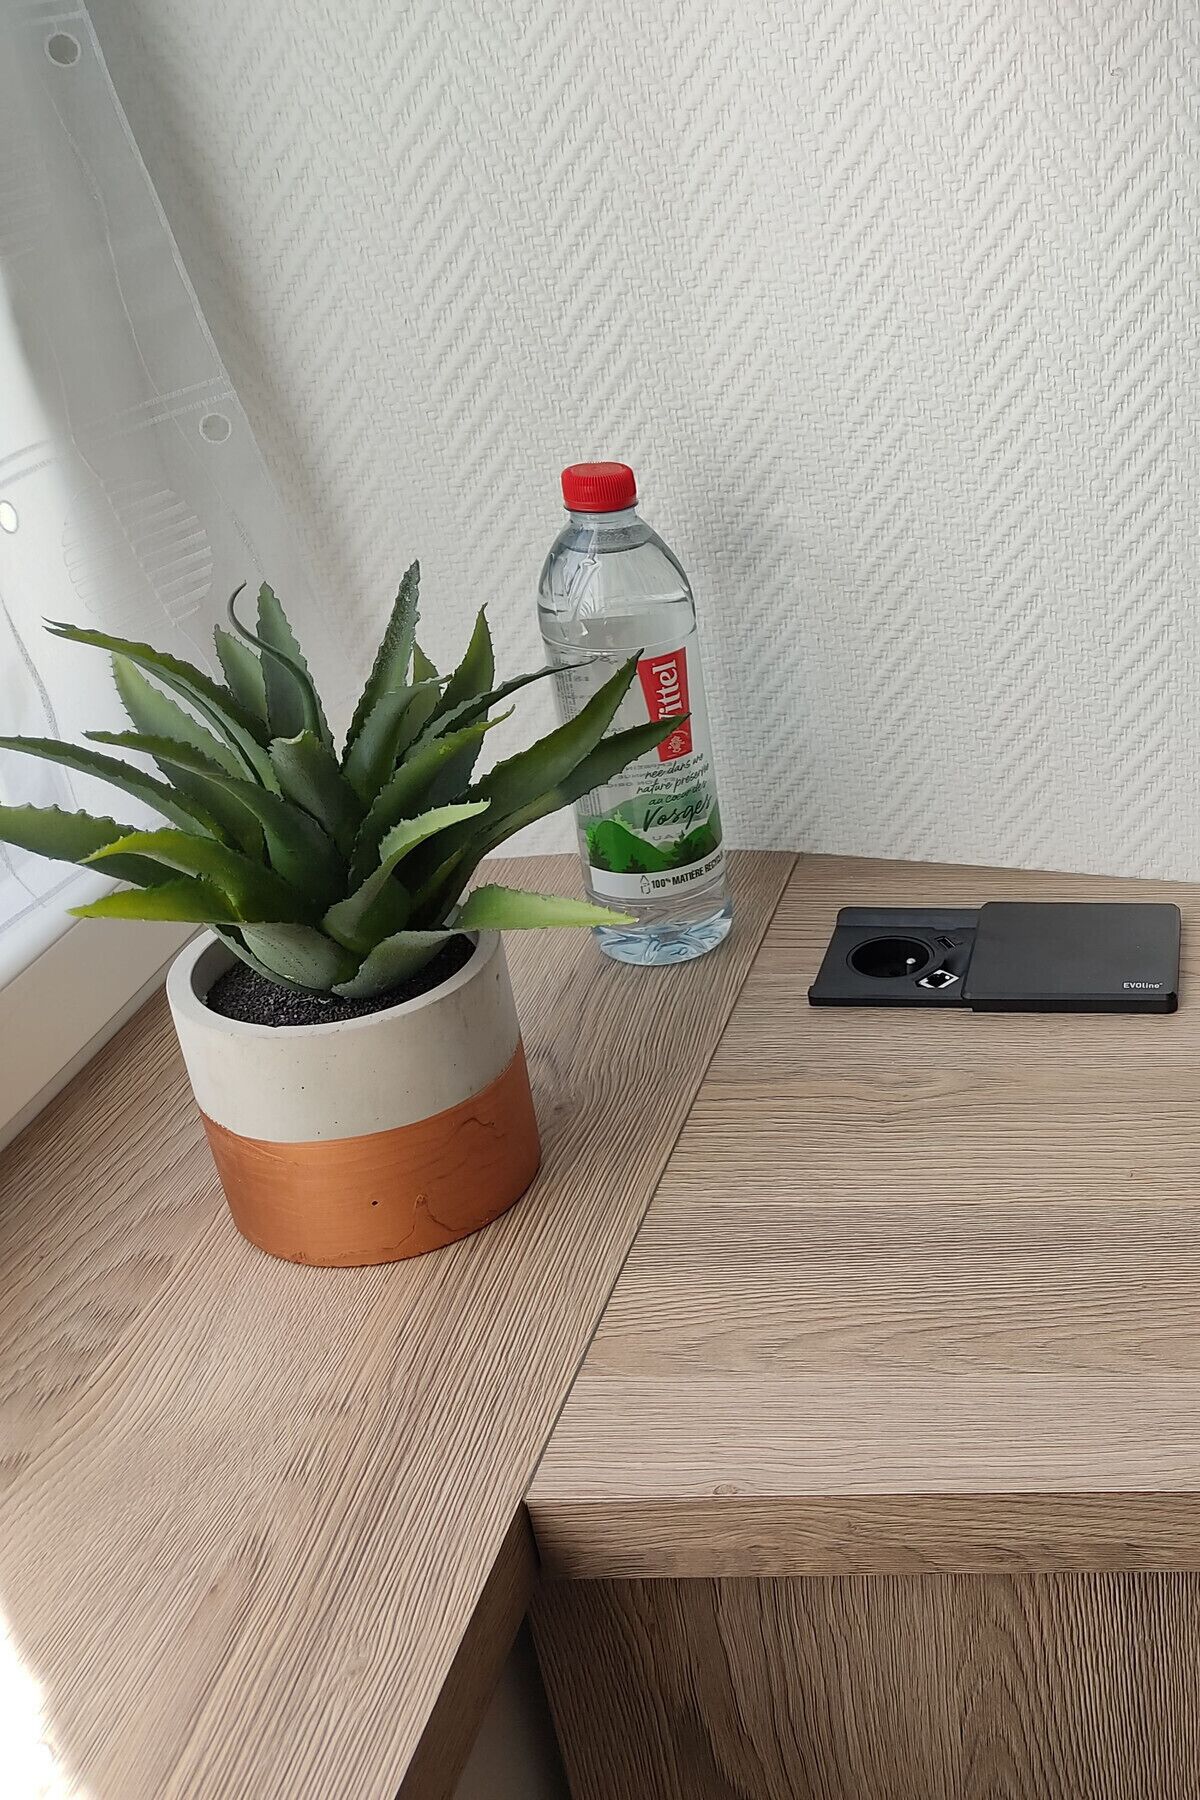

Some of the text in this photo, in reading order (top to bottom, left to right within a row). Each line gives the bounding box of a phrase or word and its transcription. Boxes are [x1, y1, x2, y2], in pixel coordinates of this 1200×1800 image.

[636, 778, 672, 794] nature
[643, 793, 712, 832] Vosges
[651, 878, 672, 890] 100%
